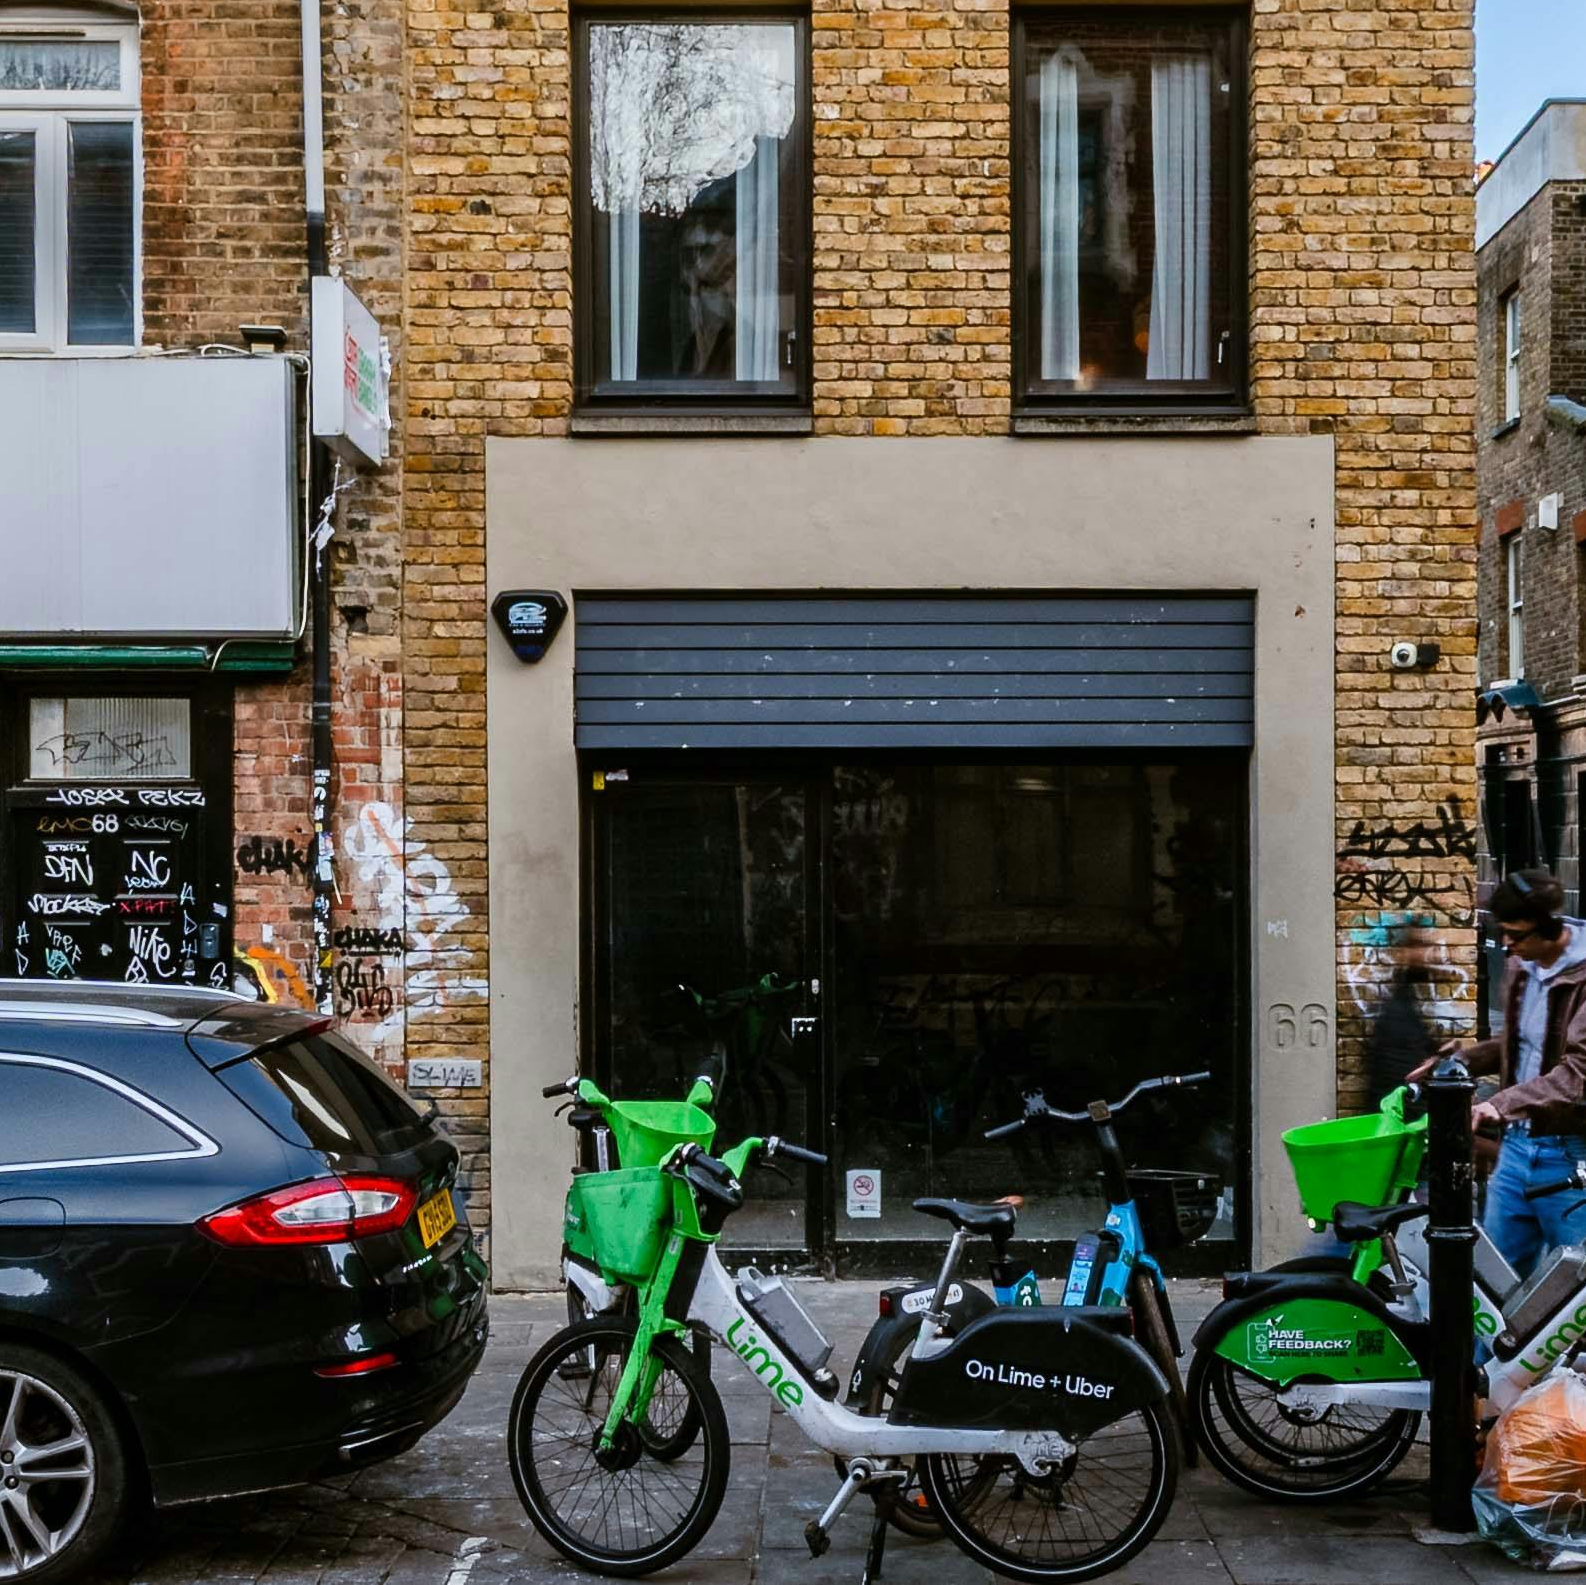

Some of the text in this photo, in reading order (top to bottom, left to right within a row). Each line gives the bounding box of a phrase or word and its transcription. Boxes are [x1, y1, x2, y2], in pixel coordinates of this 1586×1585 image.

[92, 814, 120, 833] 68
[1267, 1002, 1329, 1049] 66
[1268, 1329, 1304, 1340] HAVE
[1268, 1339, 1352, 1350] FEEDBACK?
[727, 1316, 804, 1409] Lime
[965, 1359, 994, 1381] On
[998, 1364, 1046, 1389] Lime
[1065, 1375, 1115, 1399] Uber
